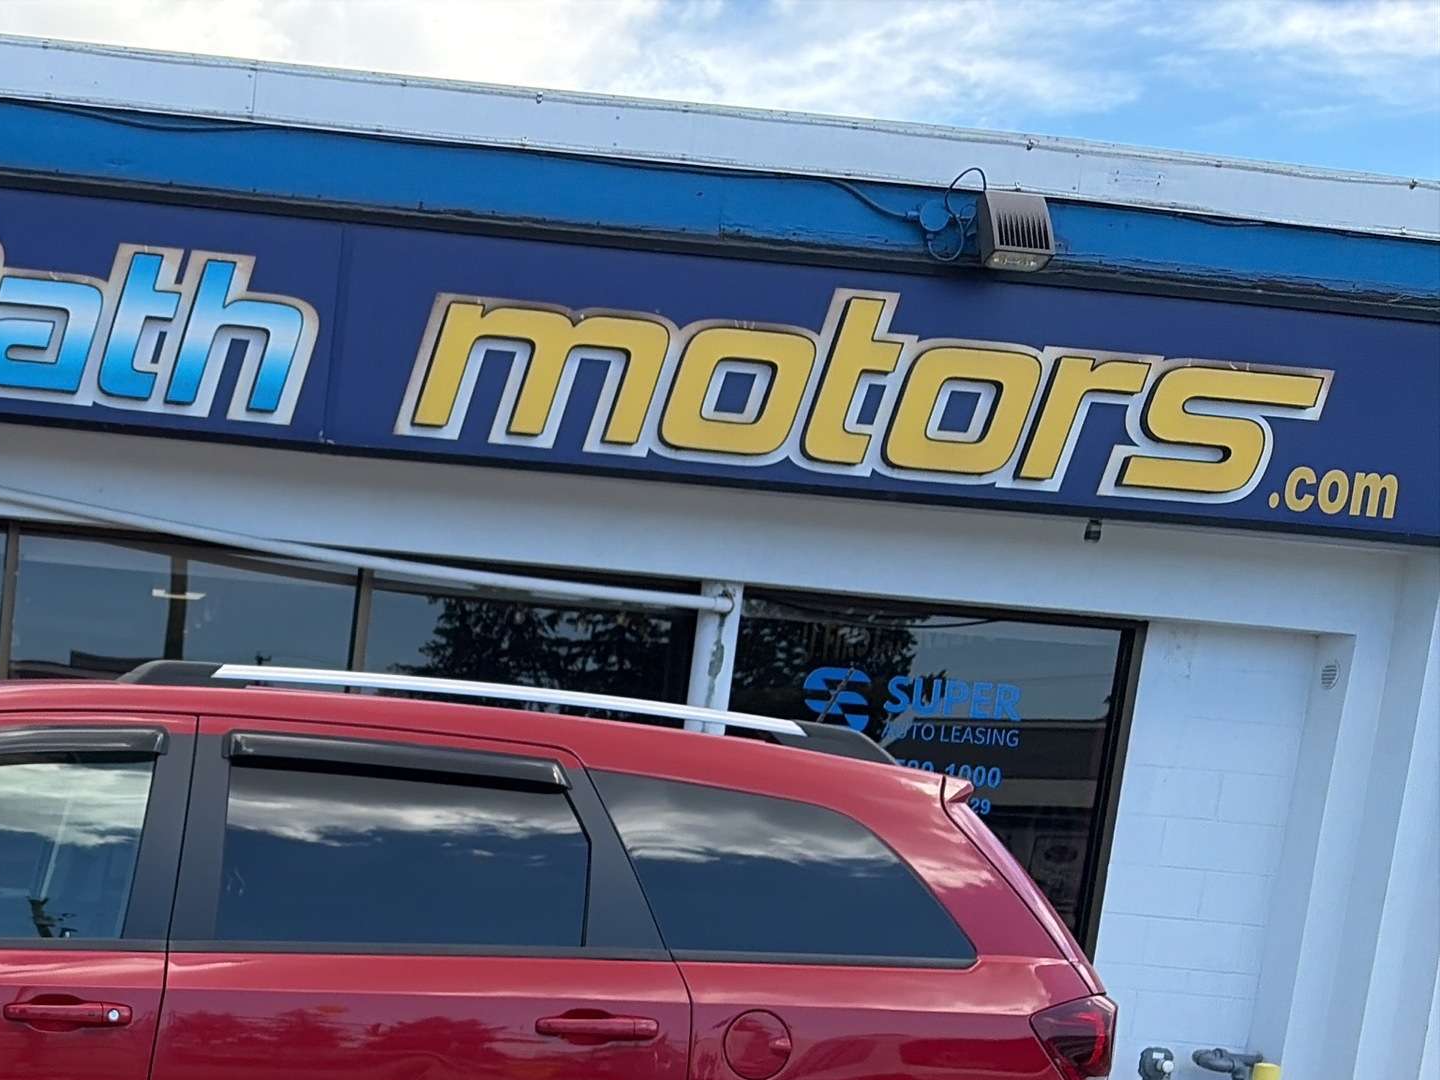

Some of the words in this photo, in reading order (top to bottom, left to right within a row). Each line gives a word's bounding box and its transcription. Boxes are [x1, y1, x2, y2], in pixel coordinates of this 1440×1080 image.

[398, 290, 1332, 501] motors
[1268, 465, 1400, 520] .com
[883, 675, 1022, 721] SUPER
[939, 722, 1021, 748] LEASING
